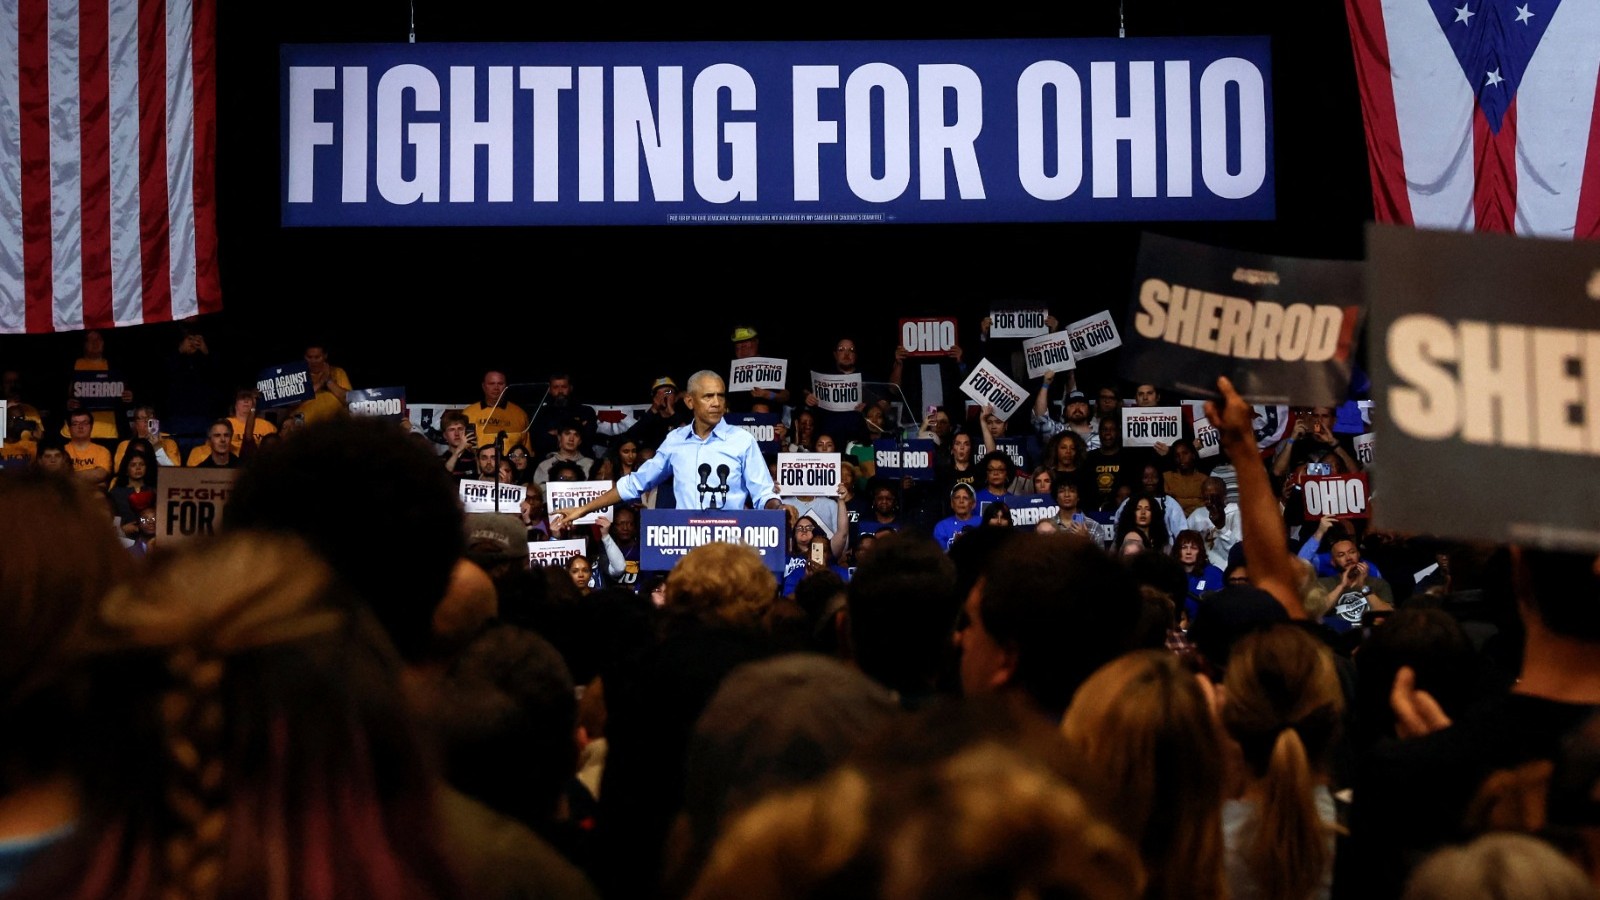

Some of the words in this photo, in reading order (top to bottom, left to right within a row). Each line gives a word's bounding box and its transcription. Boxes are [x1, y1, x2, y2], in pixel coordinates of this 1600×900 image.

[288, 63, 757, 205] FIGHTING
[792, 62, 986, 203] FOR
[1017, 57, 1266, 200] OHIO
[995, 314, 1015, 328] FOR
[1018, 313, 1044, 328] OHIO
[1068, 320, 1109, 339] IGHTING
[903, 320, 955, 352] OHIO
[1070, 335, 1087, 352] OR
[1086, 325, 1114, 347] OHIO
[1027, 340, 1066, 353] FIGHTING
[1028, 351, 1044, 370] FOR
[1044, 346, 1069, 365] OHIO
[275, 371, 307, 387] AGAINST
[734, 370, 753, 384] FOR
[755, 369, 782, 382] OHIO
[978, 368, 1020, 402] FIGHTING
[1386, 312, 1600, 457] SHE
[262, 389, 277, 401] THE
[277, 383, 305, 398] WORLD
[815, 385, 830, 402] FOR
[832, 388, 858, 402] OHIO
[969, 372, 991, 397] FOR
[989, 391, 1017, 413] OHIO
[1127, 422, 1148, 437] FOR
[1151, 421, 1177, 437] OHIO
[781, 469, 804, 486] FOR
[807, 469, 836, 486] OHIO
[1304, 478, 1366, 516] OHIO
[167, 501, 215, 536] FOR
[647, 526, 711, 546] FIGHTING
[744, 526, 778, 547] OHIO
[530, 550, 581, 559] IGHTING
